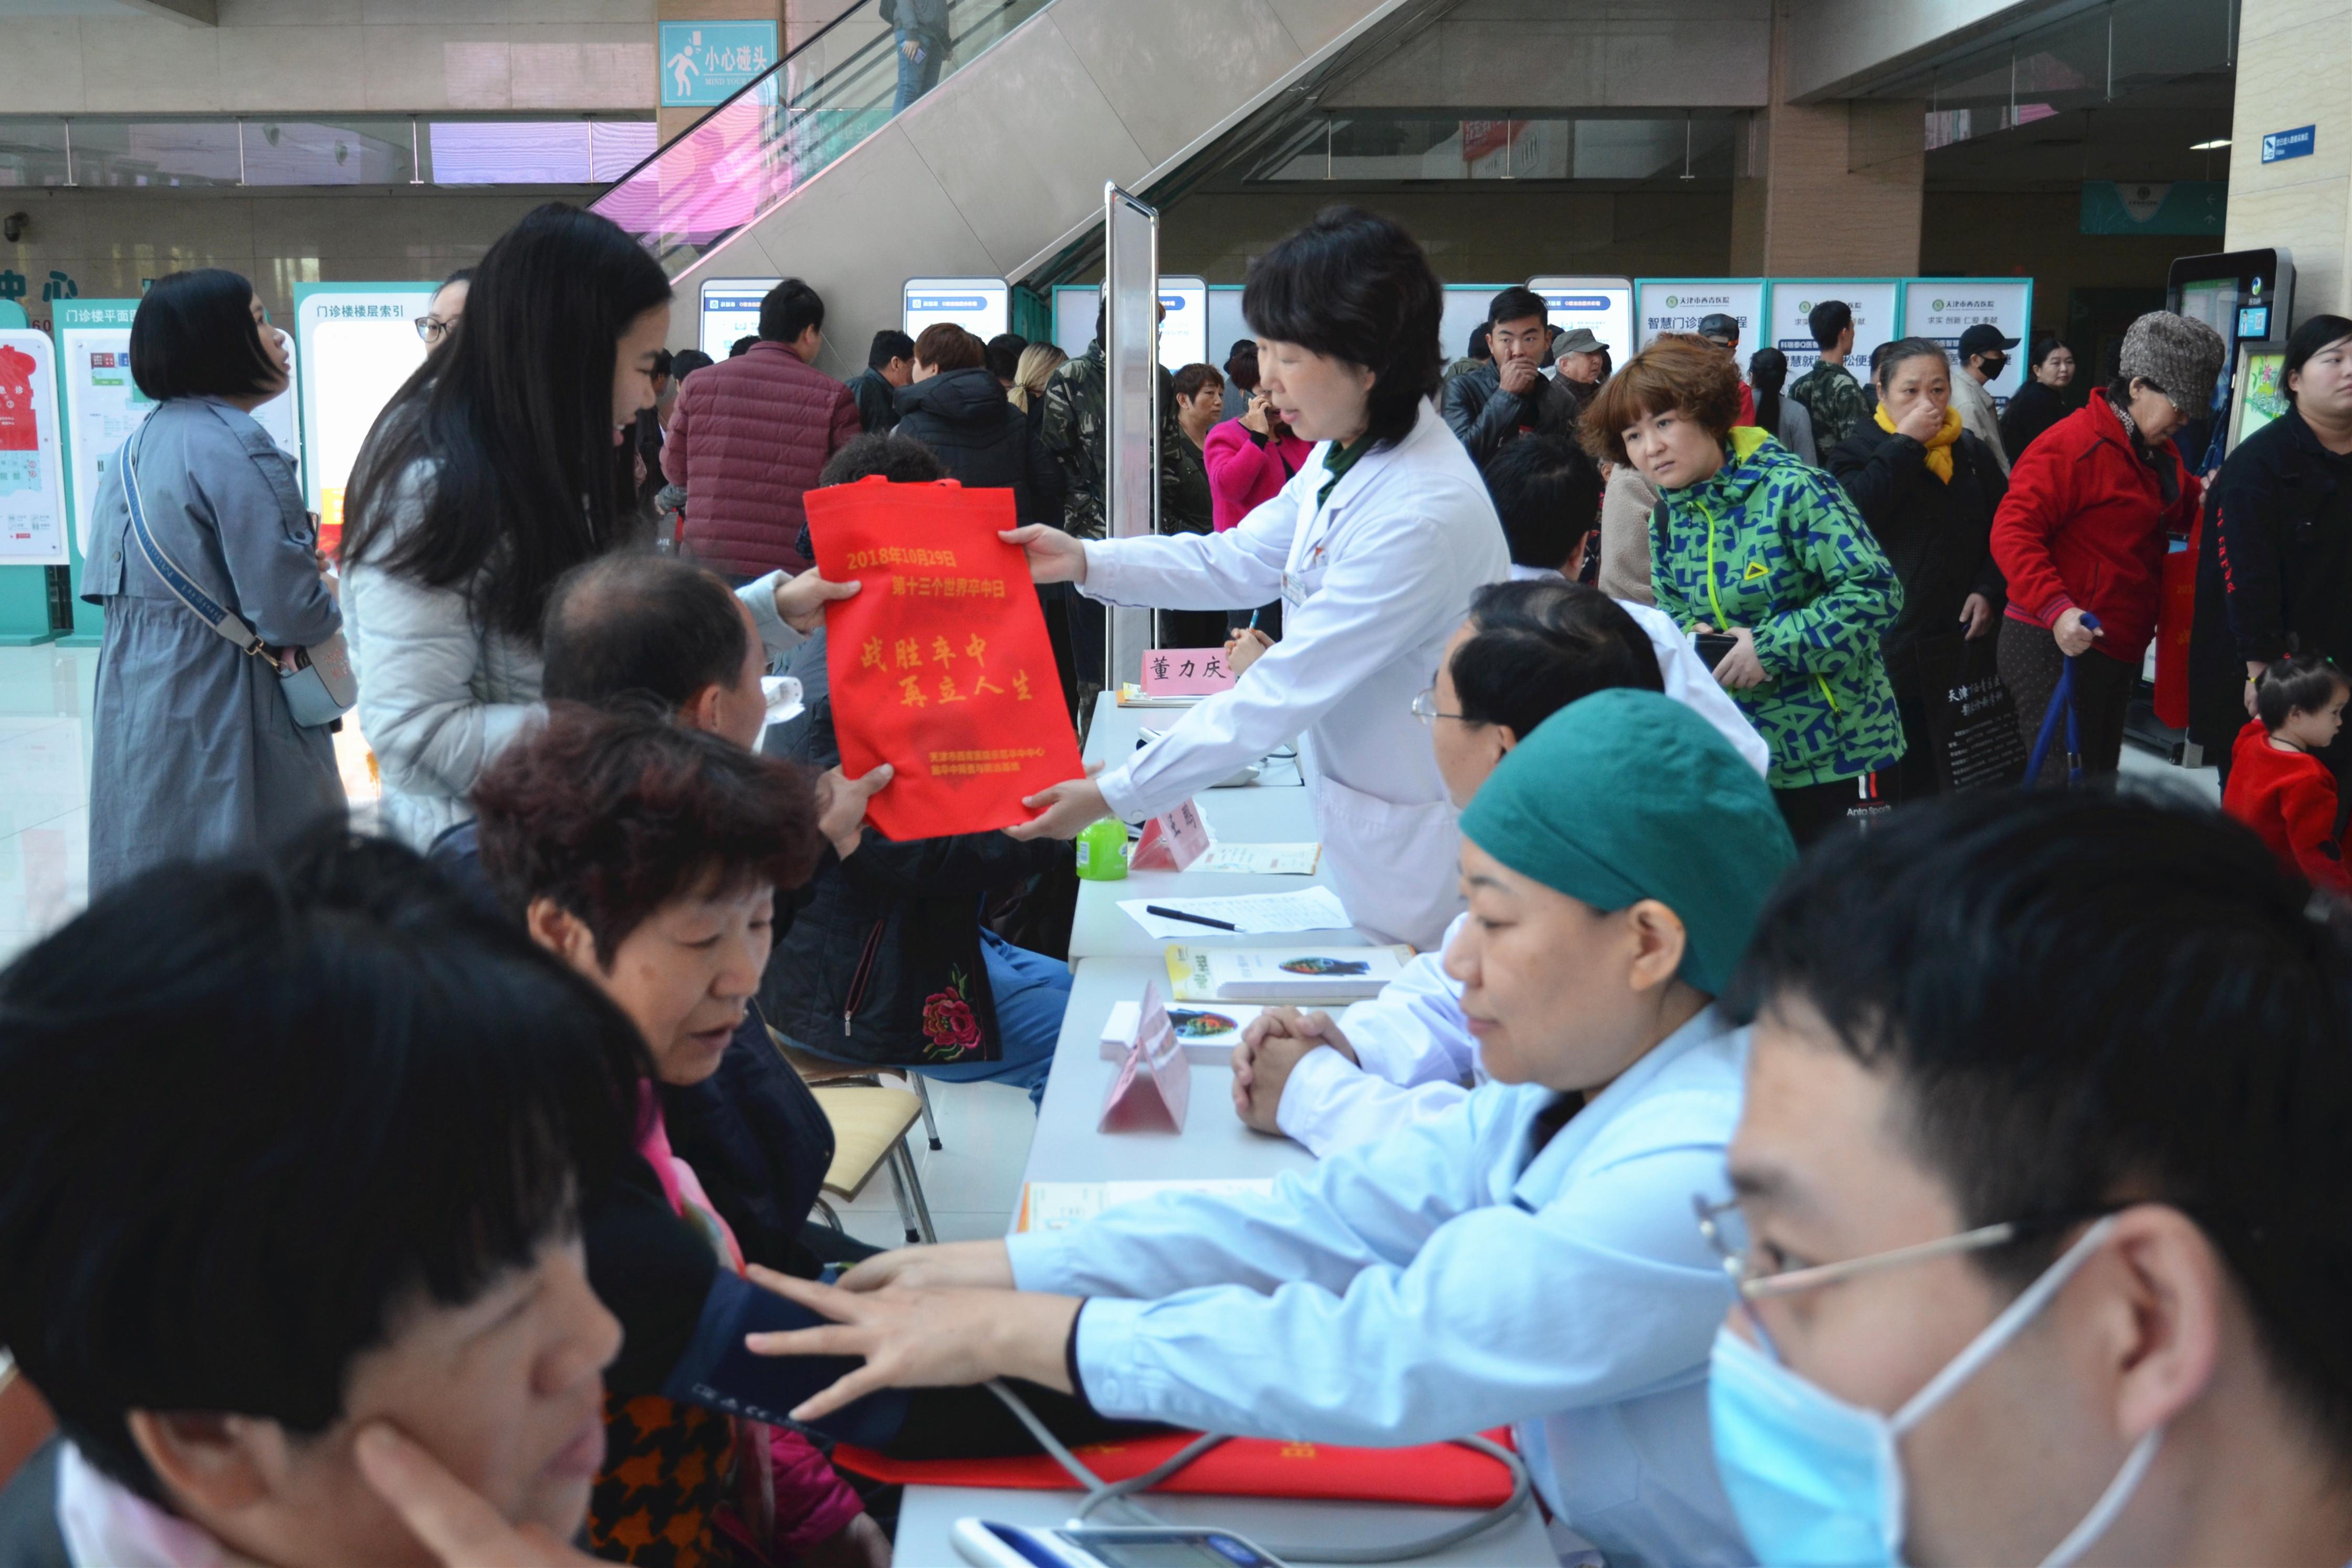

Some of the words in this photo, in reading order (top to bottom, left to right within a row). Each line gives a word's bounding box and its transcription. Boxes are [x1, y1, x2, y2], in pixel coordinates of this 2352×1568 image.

[705, 45, 768, 72] 小心碰头
[705, 77, 725, 86] MIND
[727, 77, 746, 85] YOUR
[1680, 296, 1730, 305] 天津市西青医院
[317, 305, 403, 318] 门诊楼楼层索引
[1928, 317, 1943, 325] 求实
[1982, 316, 1999, 325] 奉献
[1647, 316, 1748, 330] 智慧门诊程
[846, 546, 957, 570] 2018年10月29日
[893, 576, 1006, 598] 第十三个世界卒中日
[861, 633, 987, 672] 战胜卒中
[1149, 655, 1227, 681] 董力庆
[898, 668, 1033, 708] 再立人生
[1846, 807, 1868, 817] Anta
[1868, 804, 1891, 815] Sports
